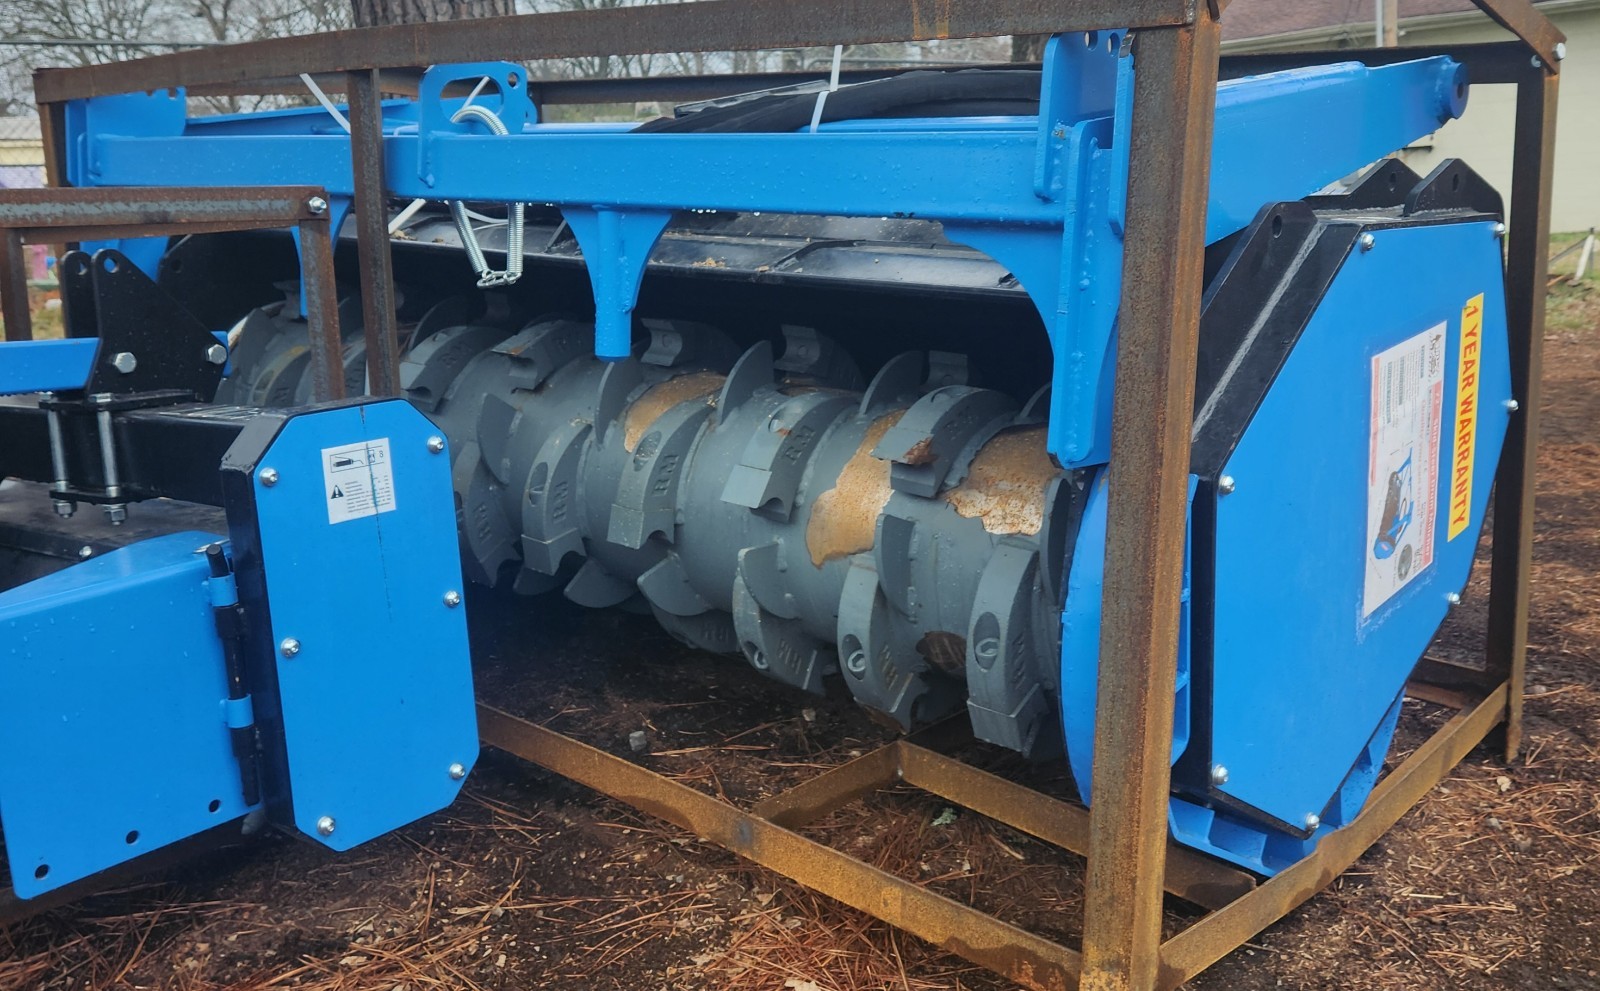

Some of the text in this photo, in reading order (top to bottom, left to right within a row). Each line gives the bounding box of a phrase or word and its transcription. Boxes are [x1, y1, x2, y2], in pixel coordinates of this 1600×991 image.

[1453, 305, 1479, 525] 1 YEAR WARRANTY
[784, 424, 816, 465] RM
[653, 455, 679, 497] RM
[553, 480, 569, 524] RM
